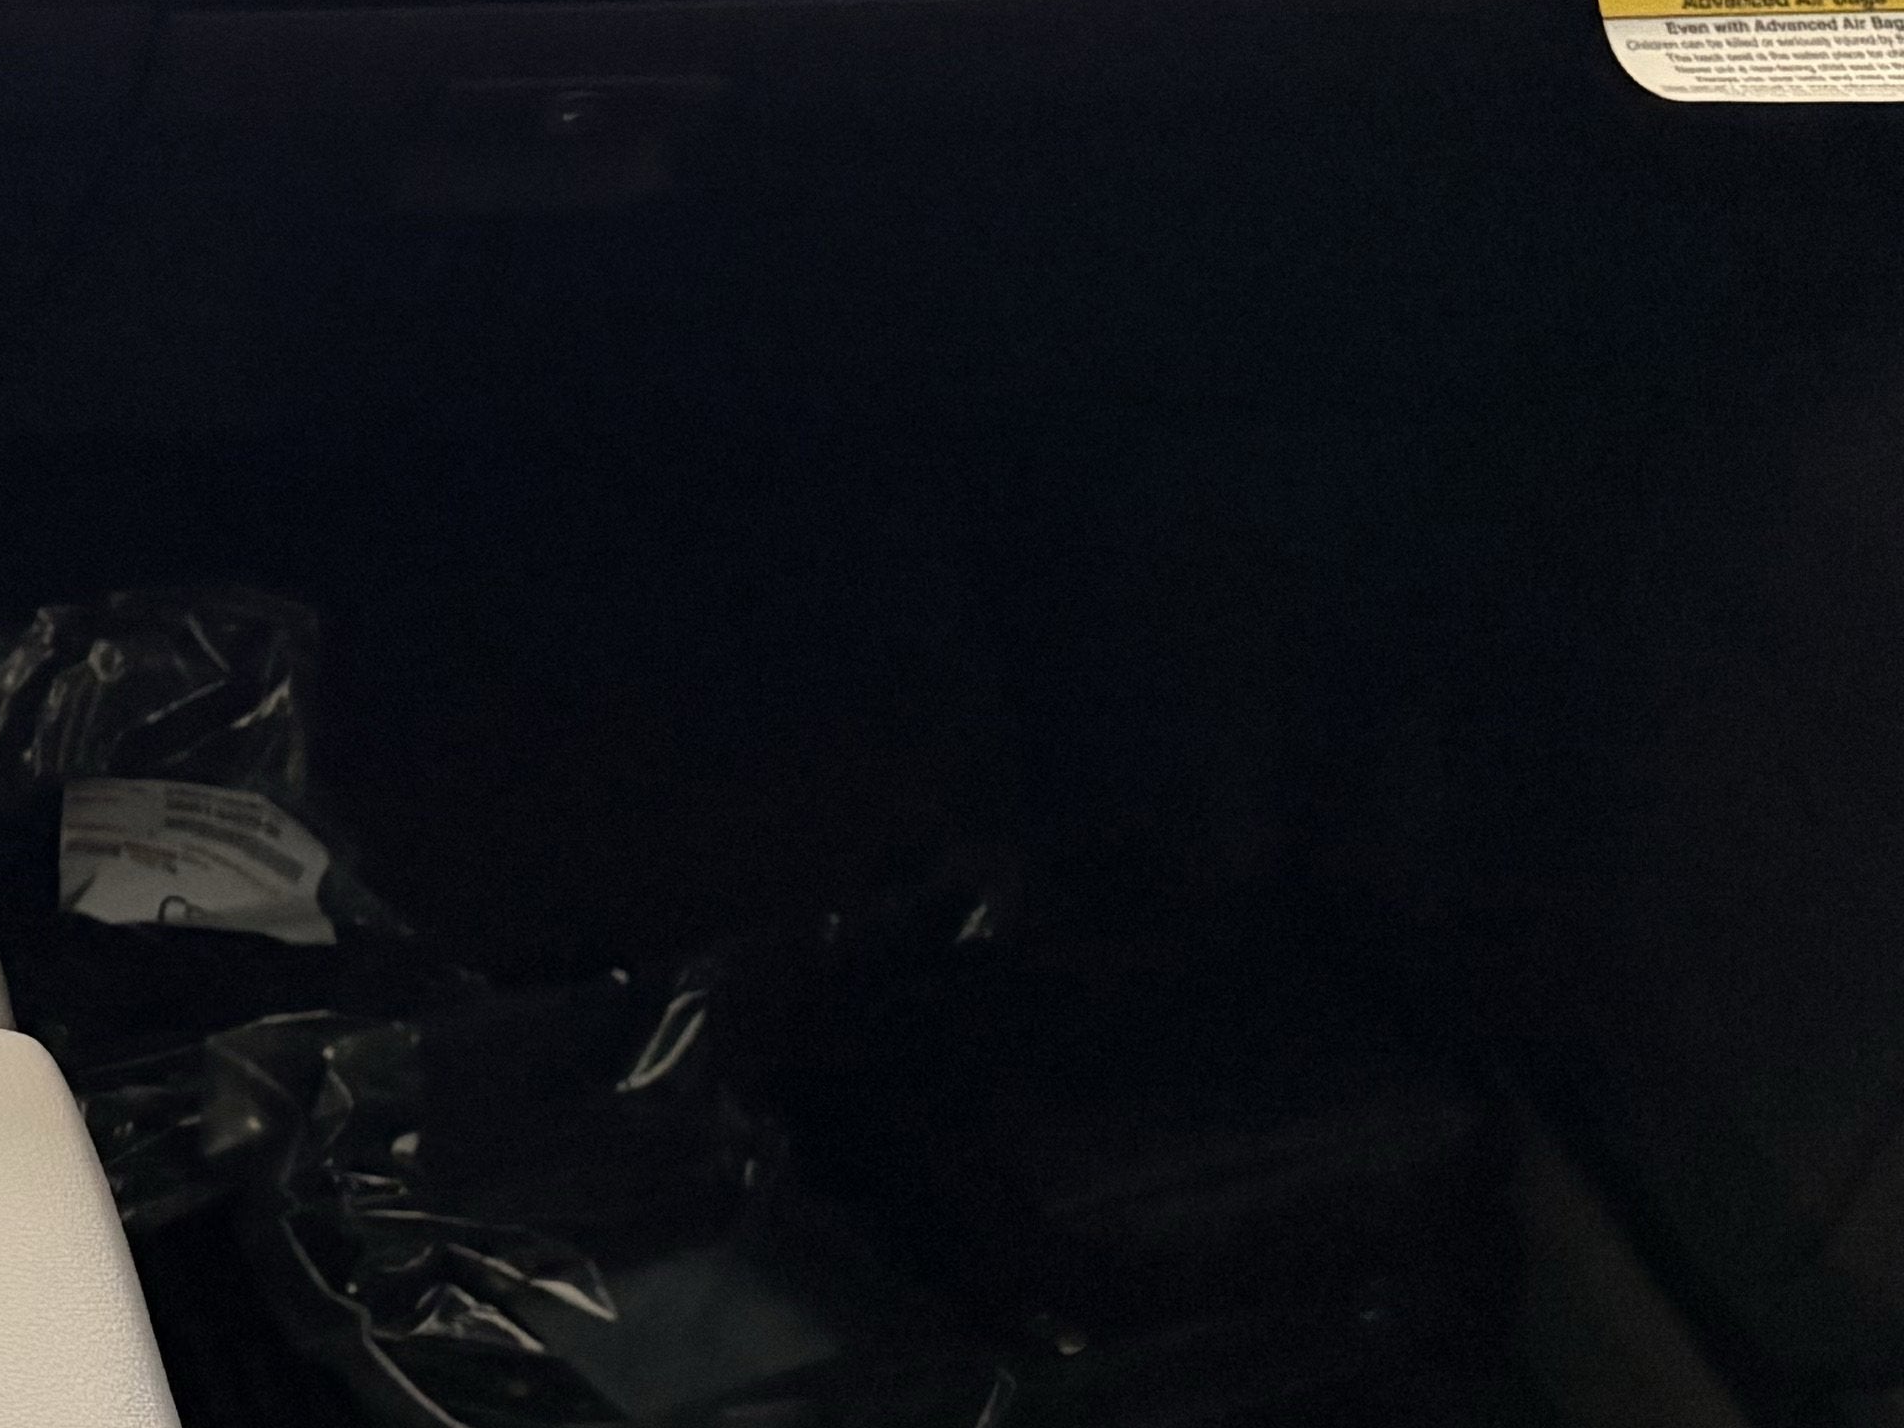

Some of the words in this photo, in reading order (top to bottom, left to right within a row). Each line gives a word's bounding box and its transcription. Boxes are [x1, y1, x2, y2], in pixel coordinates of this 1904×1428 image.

[1665, 22, 1709, 35] Even
[1713, 20, 1750, 33] with
[1754, 19, 1837, 32] Advanced
[1843, 17, 1865, 29] Air
